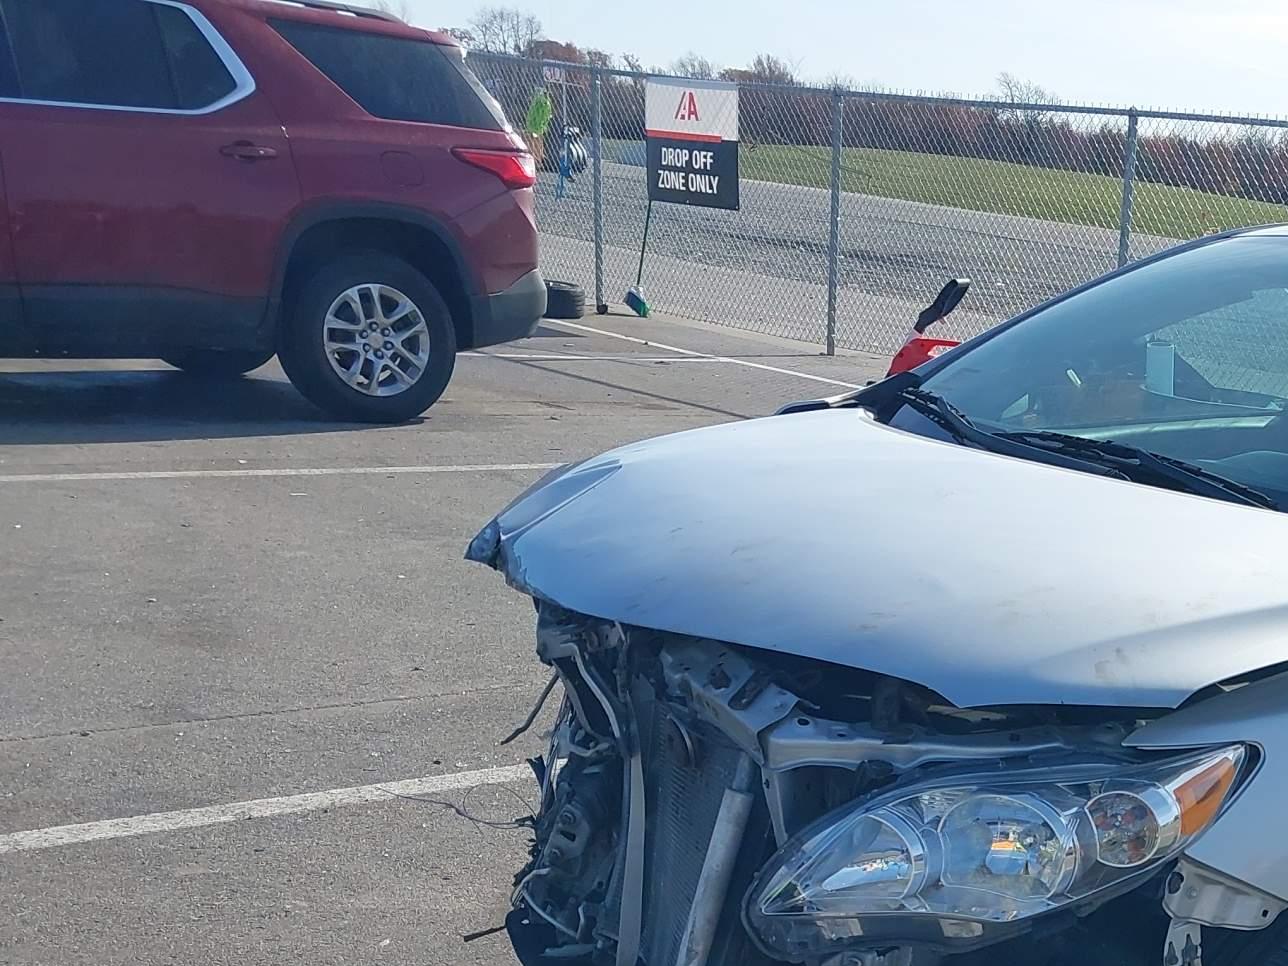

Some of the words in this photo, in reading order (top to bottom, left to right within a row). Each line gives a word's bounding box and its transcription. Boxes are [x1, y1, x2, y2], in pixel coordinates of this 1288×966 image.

[661, 147, 689, 168] DROP
[692, 150, 713, 170] OFF
[658, 170, 686, 190] ZONE
[688, 174, 719, 194] ONLY
